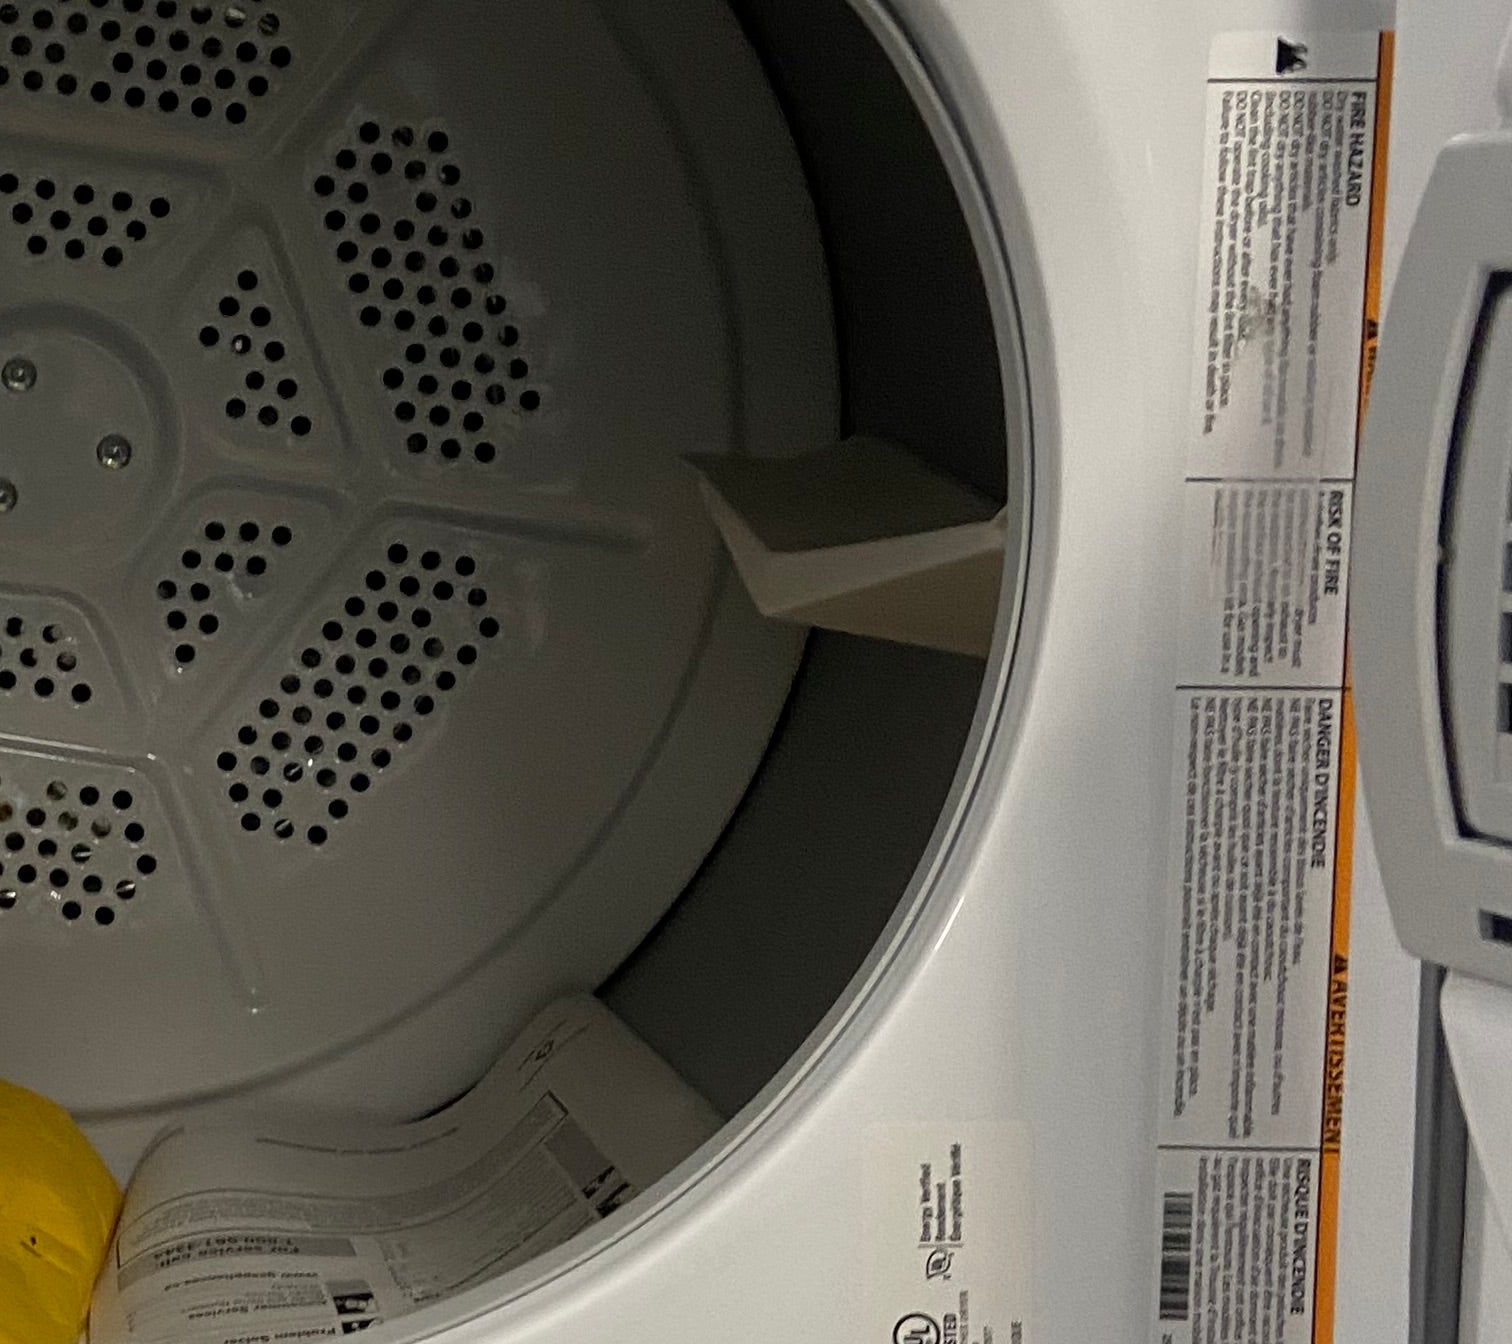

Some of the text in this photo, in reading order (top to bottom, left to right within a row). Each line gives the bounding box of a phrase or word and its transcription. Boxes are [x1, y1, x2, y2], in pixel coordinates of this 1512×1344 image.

[1346, 90, 1367, 207] FIRE HAZARD
[1323, 490, 1345, 597] RISK OF FIRE
[1315, 698, 1335, 770] DANGER
